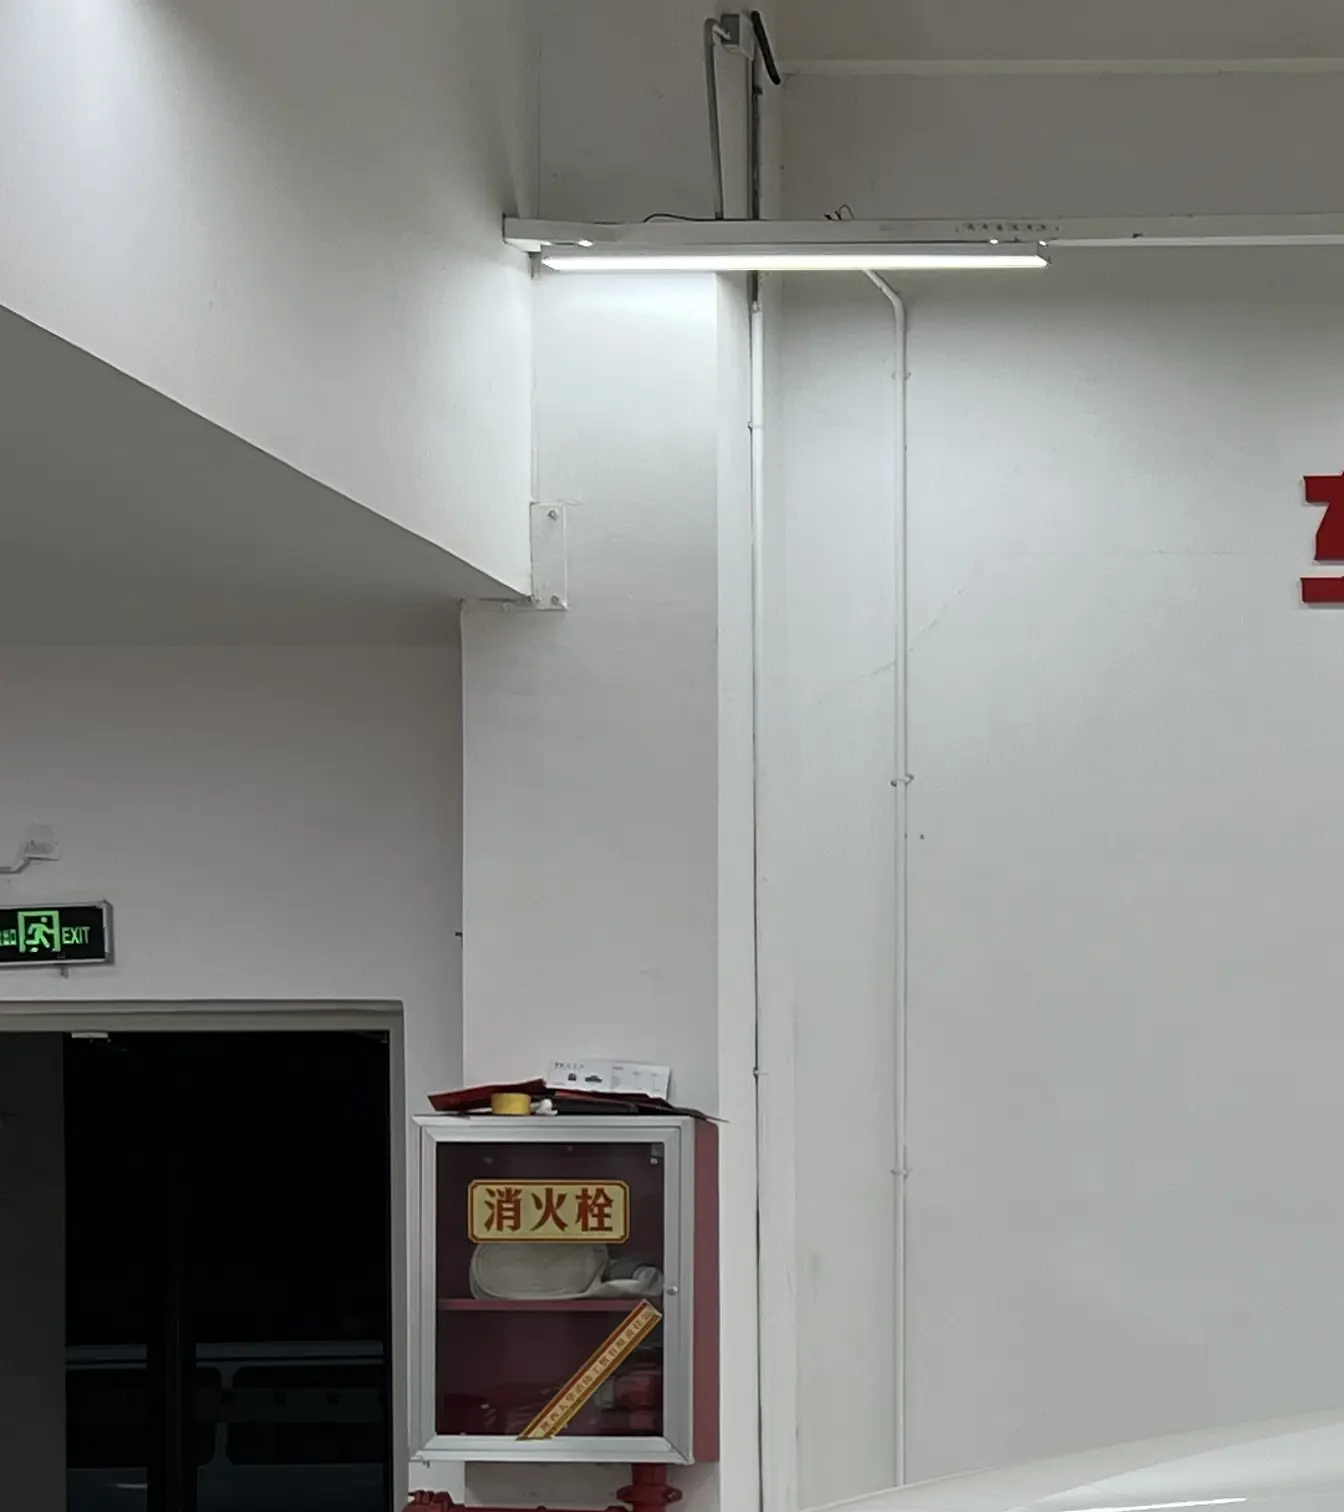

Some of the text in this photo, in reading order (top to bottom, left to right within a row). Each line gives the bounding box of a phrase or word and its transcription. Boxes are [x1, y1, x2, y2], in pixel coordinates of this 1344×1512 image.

[62, 926, 90, 944] EXIT
[484, 1187, 613, 1231] 消火栓
